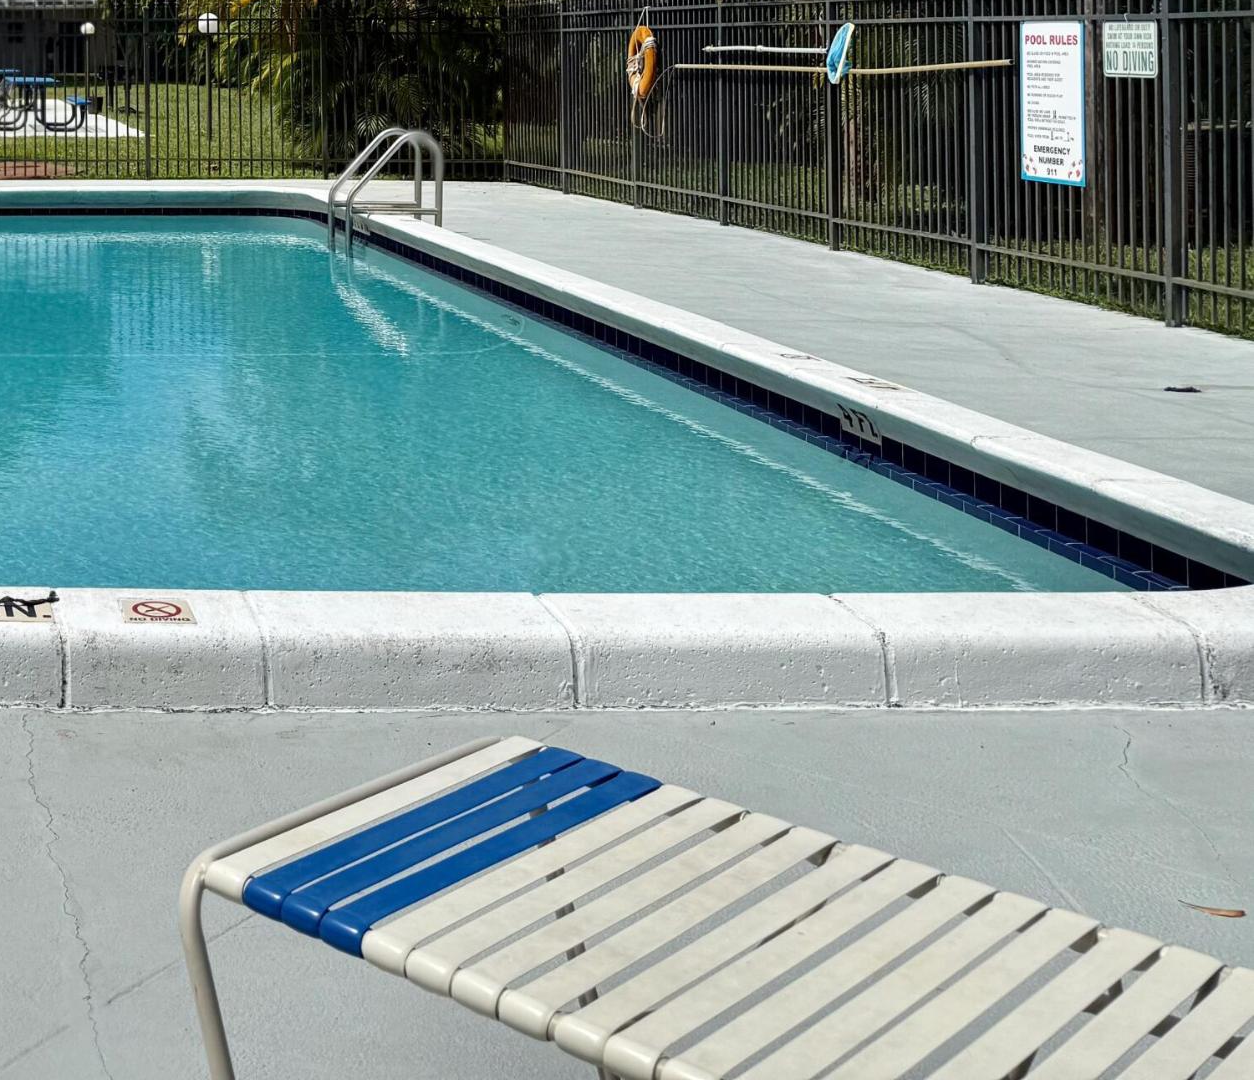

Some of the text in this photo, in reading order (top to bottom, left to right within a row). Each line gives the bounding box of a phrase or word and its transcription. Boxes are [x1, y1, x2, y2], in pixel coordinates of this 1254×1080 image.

[1025, 35, 1078, 46] POOL RULES
[1106, 50, 1154, 72] NO DIVING
[1033, 145, 1071, 156] EMERGENCY
[1038, 156, 1065, 167] NUMBER
[1046, 168, 1057, 176] 911
